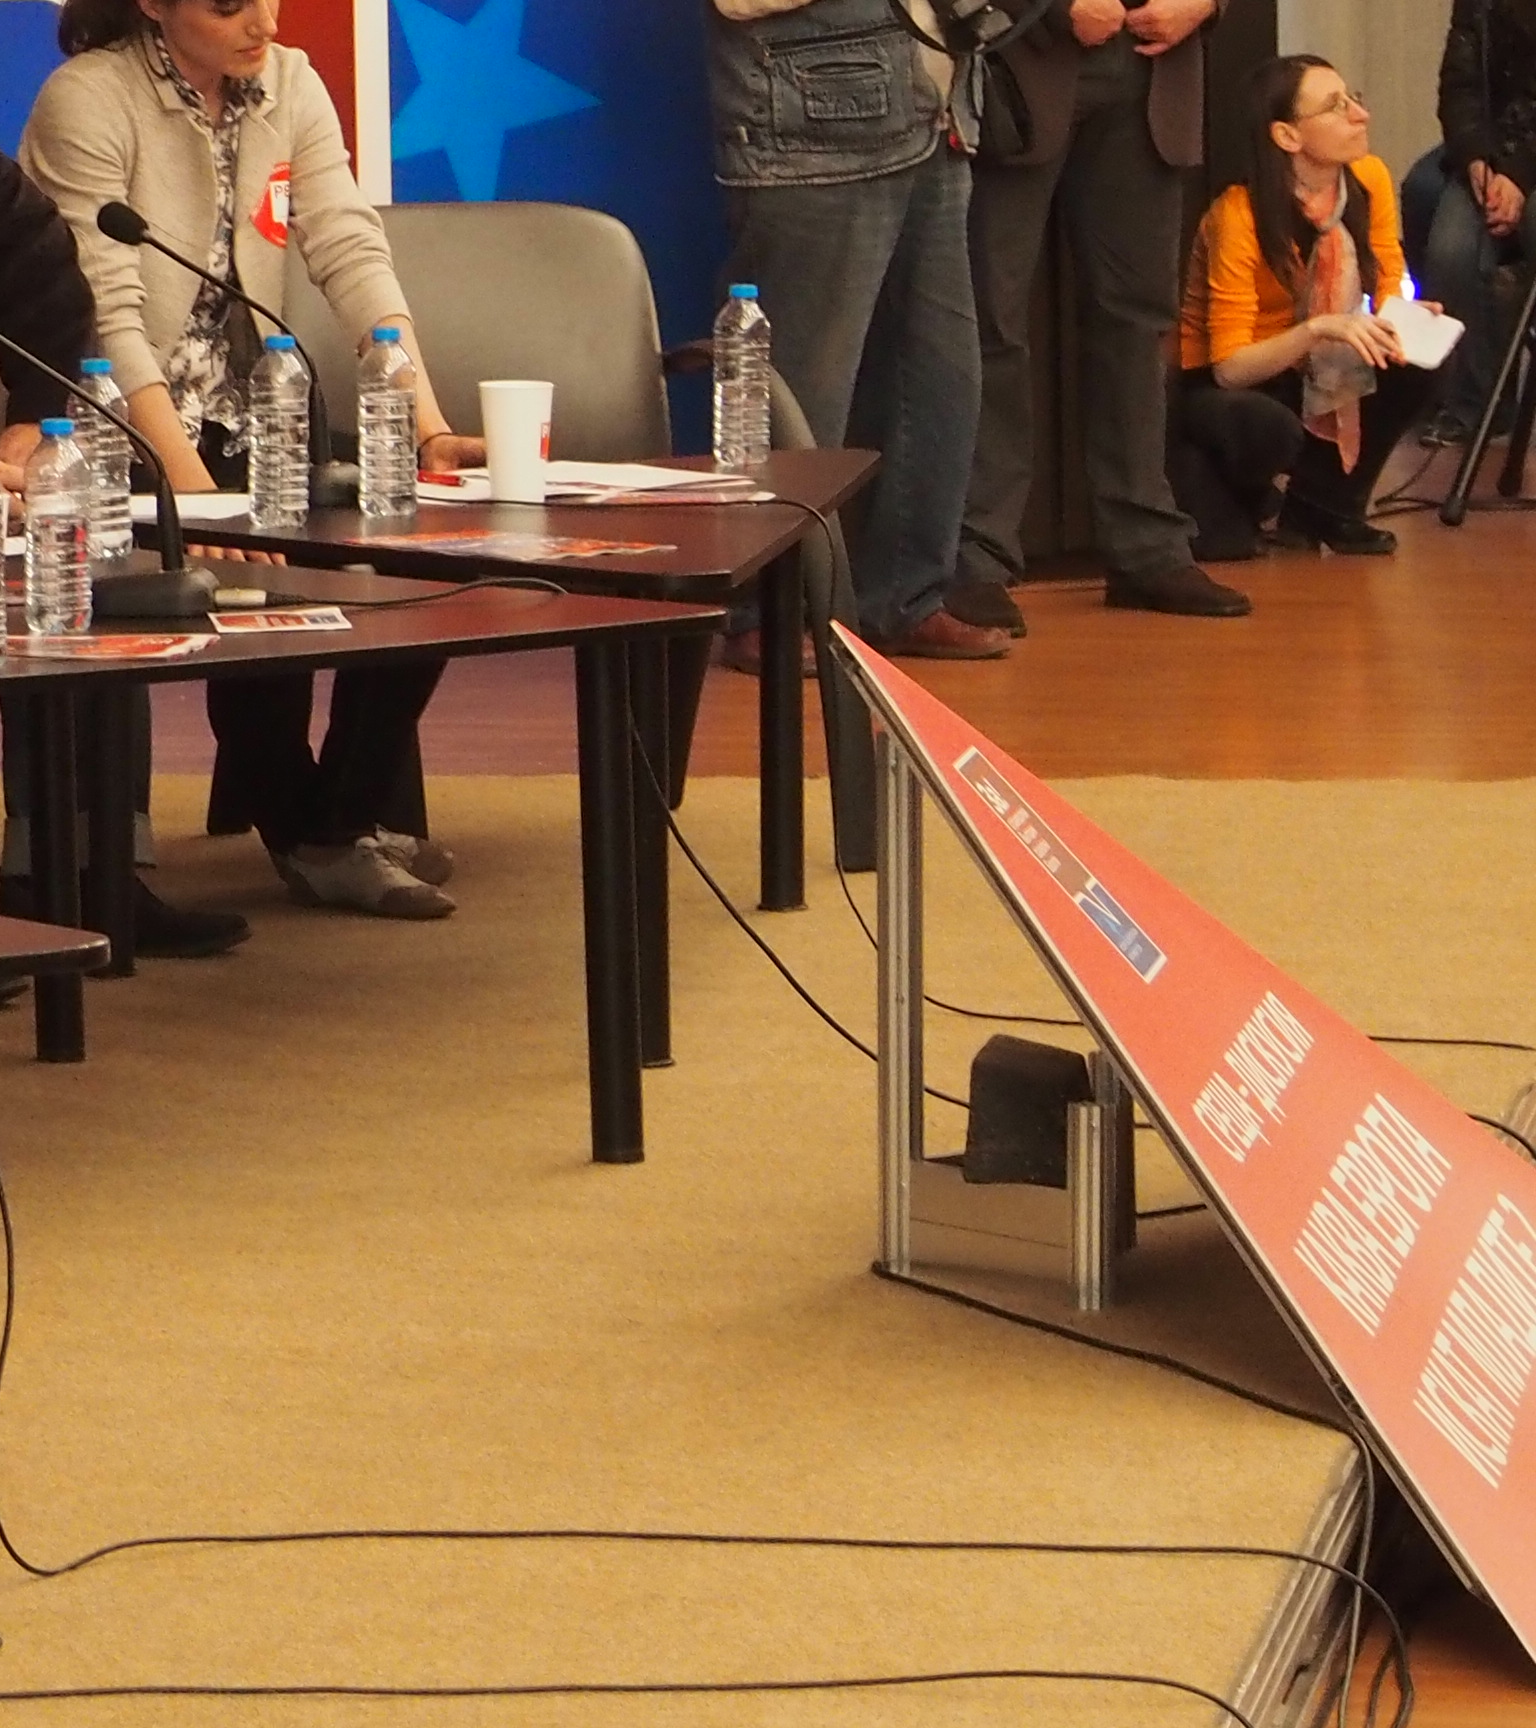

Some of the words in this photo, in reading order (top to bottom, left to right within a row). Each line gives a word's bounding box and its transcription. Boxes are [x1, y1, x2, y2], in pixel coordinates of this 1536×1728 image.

[1329, 1092, 1452, 1258] ЕВРОПА
[1292, 1186, 1402, 1337] КАКВА
[1413, 1329, 1516, 1490] ИСКАТ
